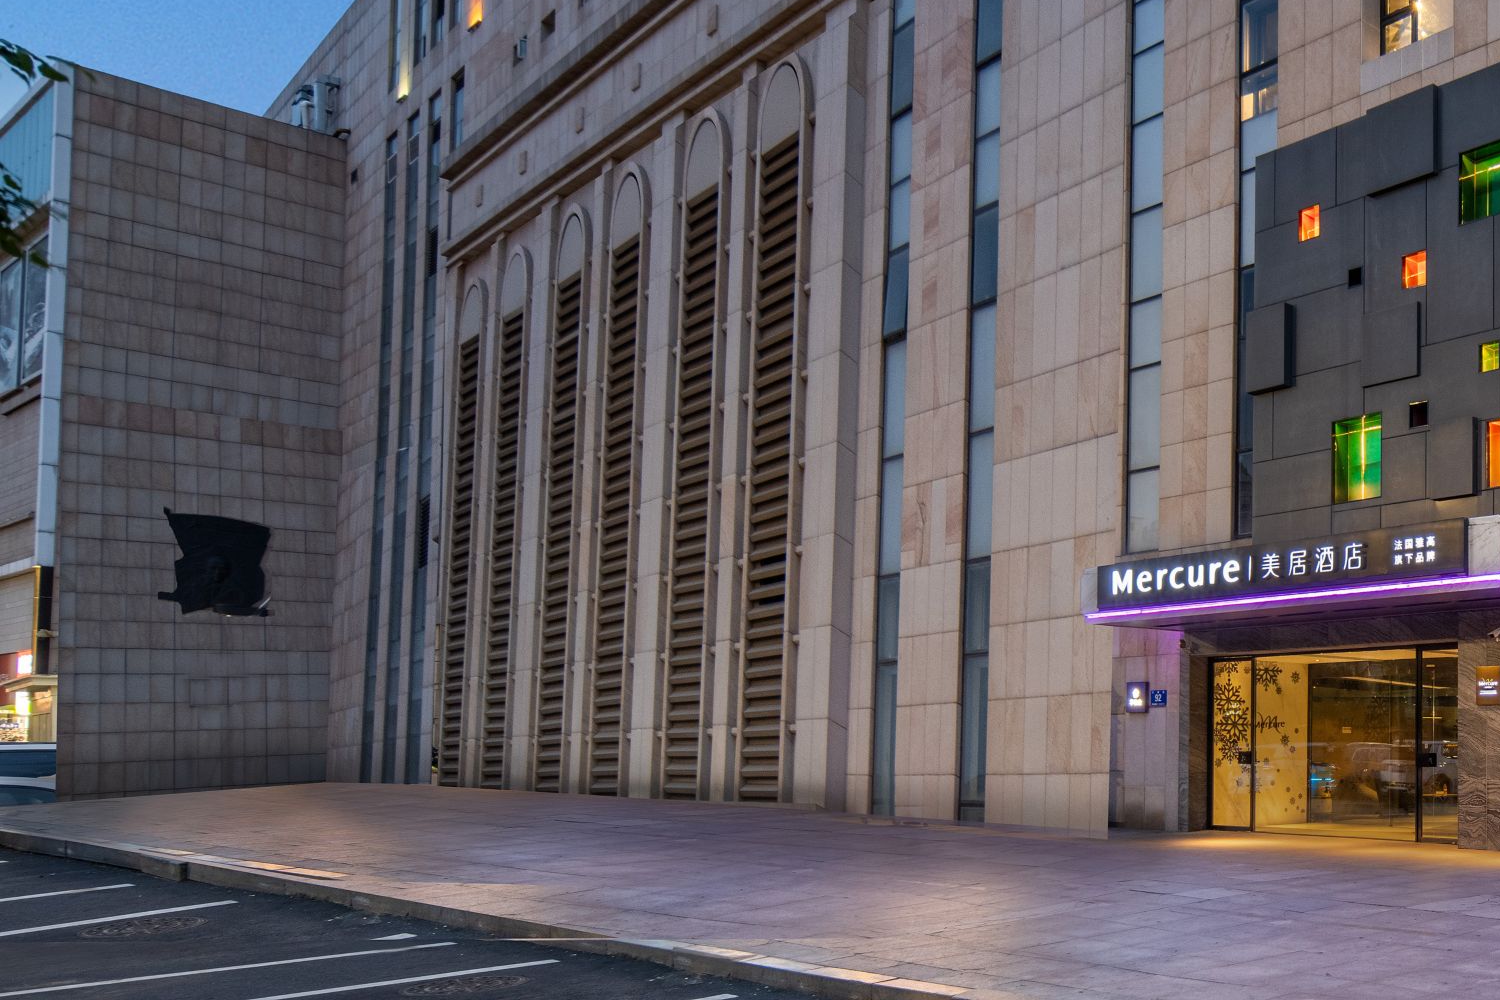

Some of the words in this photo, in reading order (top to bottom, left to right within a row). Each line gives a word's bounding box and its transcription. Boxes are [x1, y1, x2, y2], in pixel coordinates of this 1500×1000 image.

[1111, 558, 1240, 596] Mercure
[1261, 542, 1364, 580] 美居酒店
[1154, 693, 1163, 702] 92
